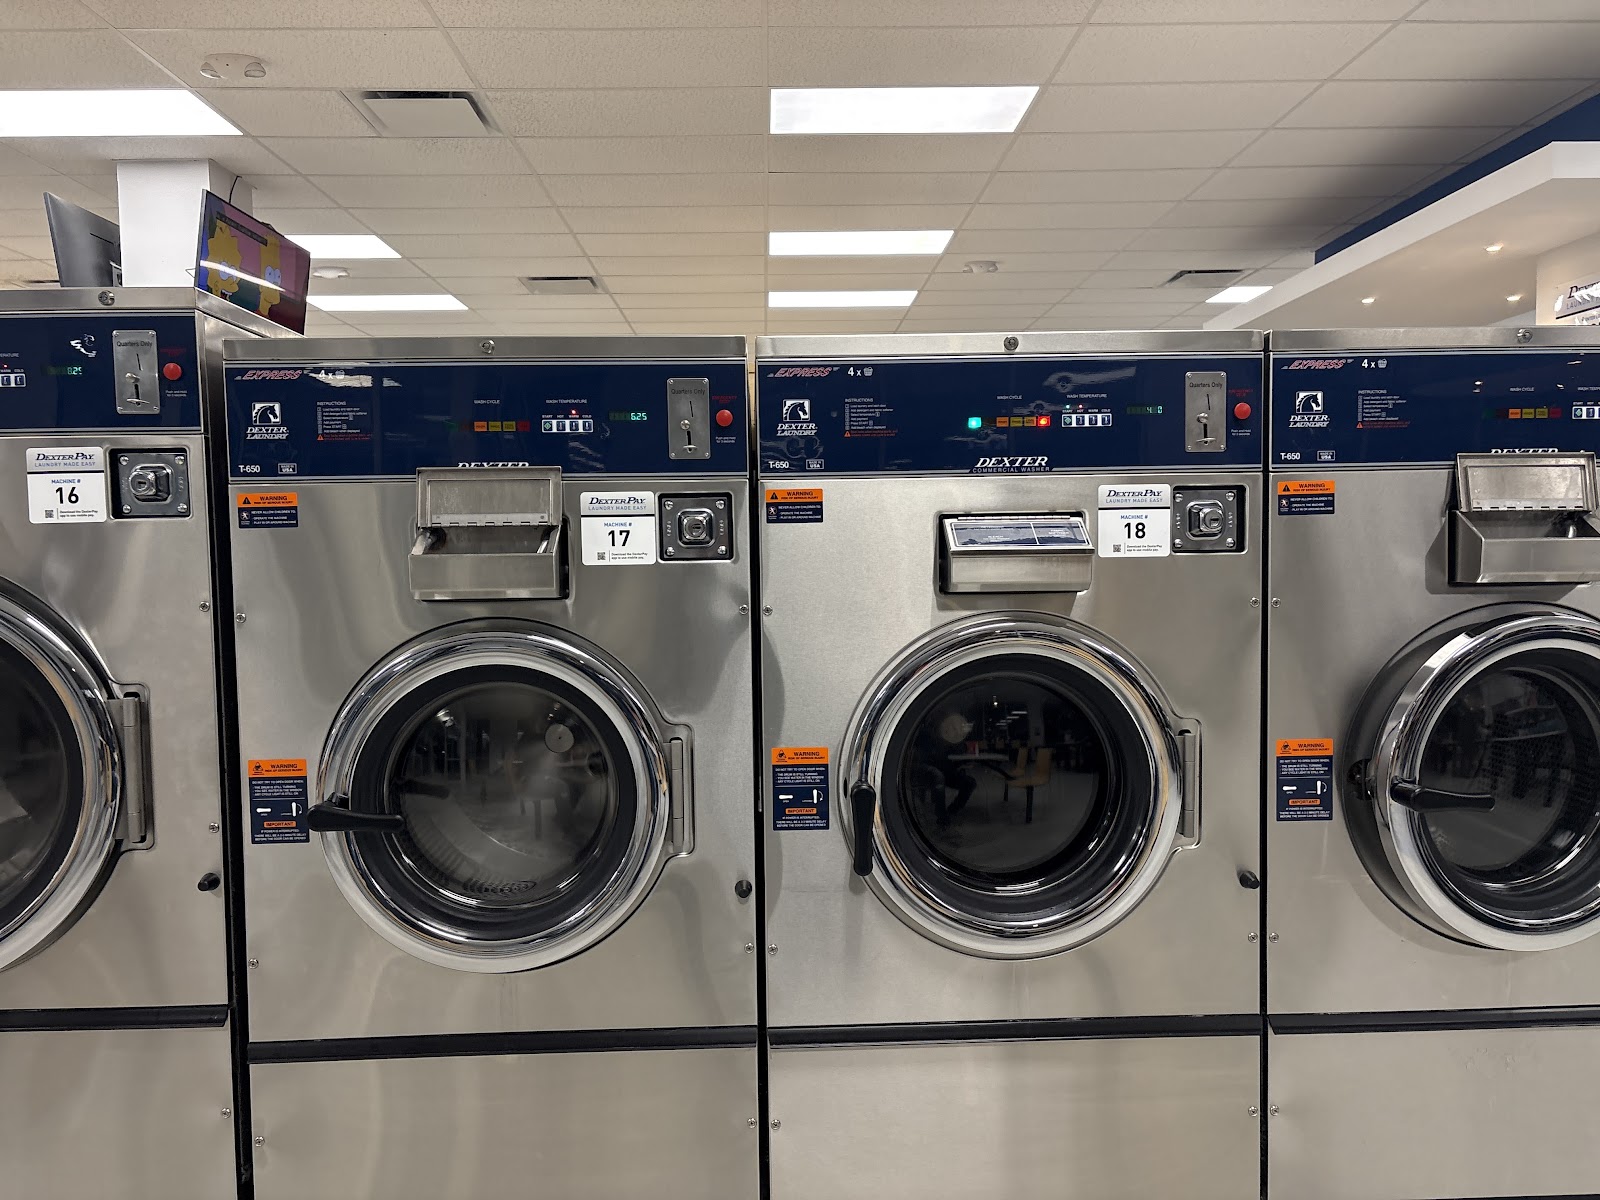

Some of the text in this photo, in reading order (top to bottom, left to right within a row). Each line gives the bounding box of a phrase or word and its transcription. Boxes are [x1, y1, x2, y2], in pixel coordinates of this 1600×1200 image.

[1289, 360, 1346, 369] EXPRESS
[1362, 359, 1368, 368] 4
[242, 370, 302, 380] EXPRESS
[320, 370, 325, 379] 4
[775, 367, 832, 377] EXPRESS
[848, 367, 854, 376] 4
[975, 456, 1048, 467] DEXTER
[56, 487, 79, 504] 16
[1124, 523, 1146, 539] 18
[608, 530, 630, 546] 17
